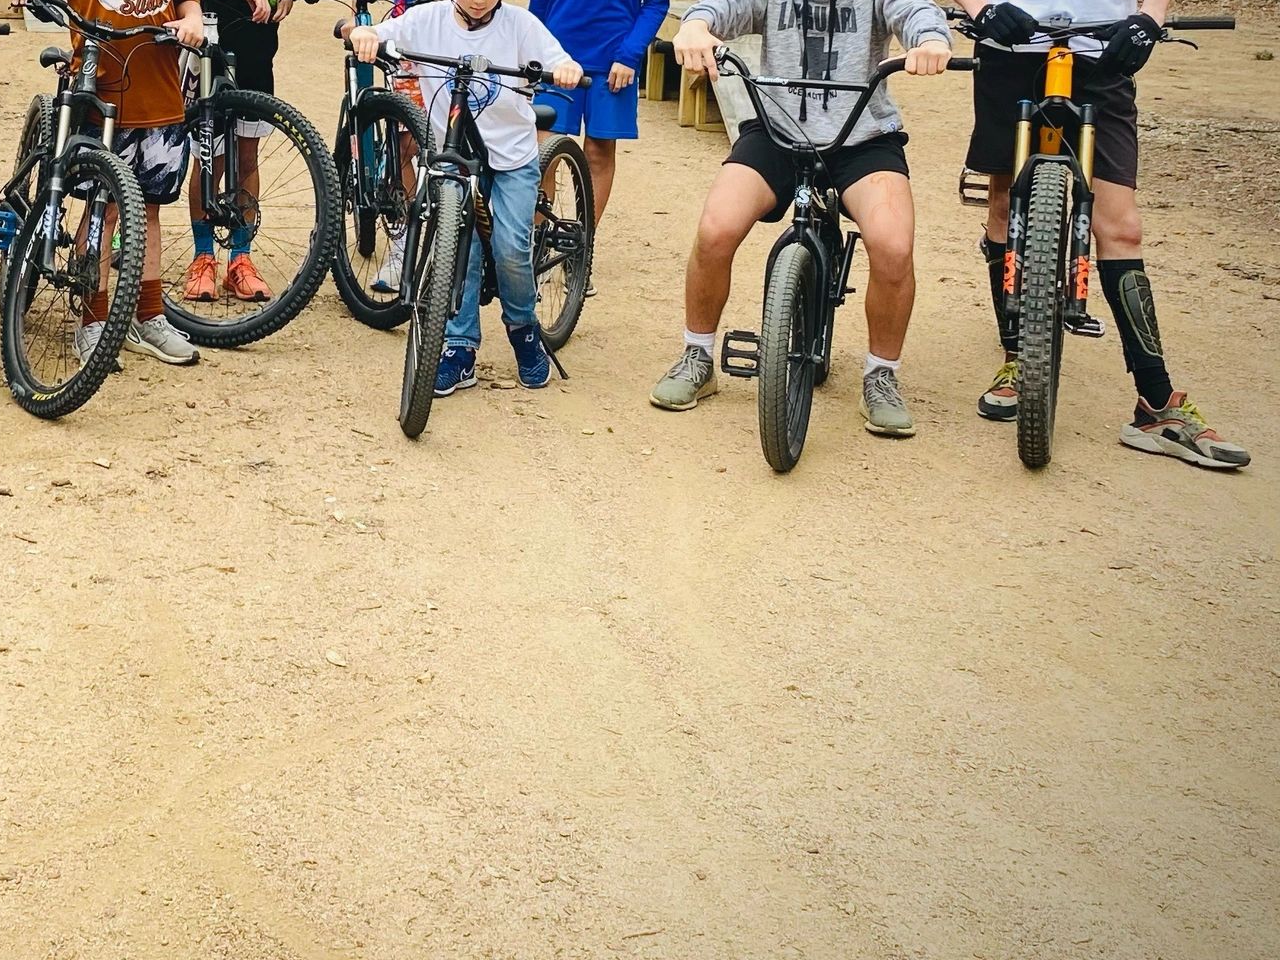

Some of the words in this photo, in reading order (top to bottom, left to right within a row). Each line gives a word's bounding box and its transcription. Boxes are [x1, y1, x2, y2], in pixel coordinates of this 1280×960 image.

[1129, 24, 1153, 46] FOX
[200, 129, 213, 176] FOX
[273, 112, 312, 156] MAXXIS
